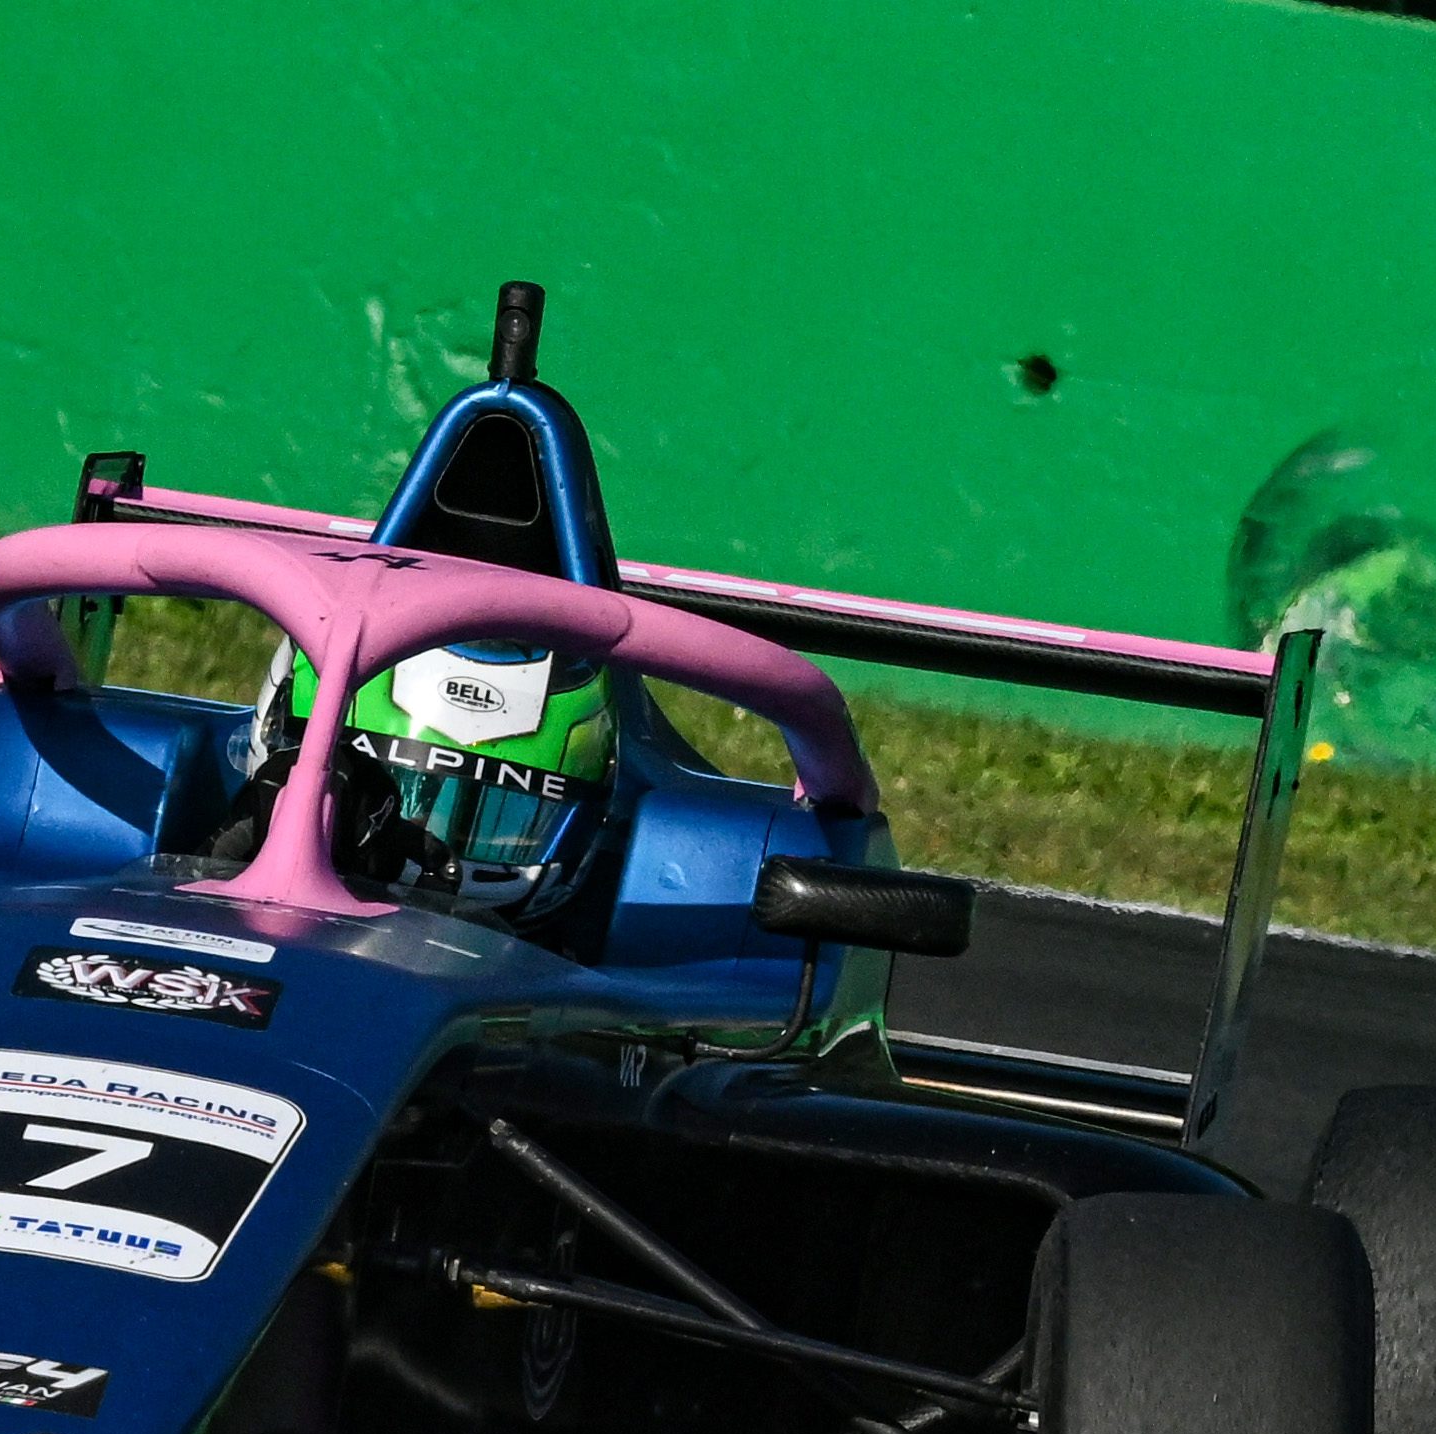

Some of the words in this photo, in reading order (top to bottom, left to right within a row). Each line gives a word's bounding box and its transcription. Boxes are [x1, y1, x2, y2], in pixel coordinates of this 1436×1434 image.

[446, 681, 495, 704] BELL
[351, 733, 565, 800] ALPINE
[72, 961, 269, 1016] WSK
[106, 1082, 277, 1127] RACING
[127, 1102, 165, 1113] and
[168, 1111, 275, 1140] equipment
[22, 1123, 154, 1190] 7
[9, 1216, 183, 1257] TATUUS
